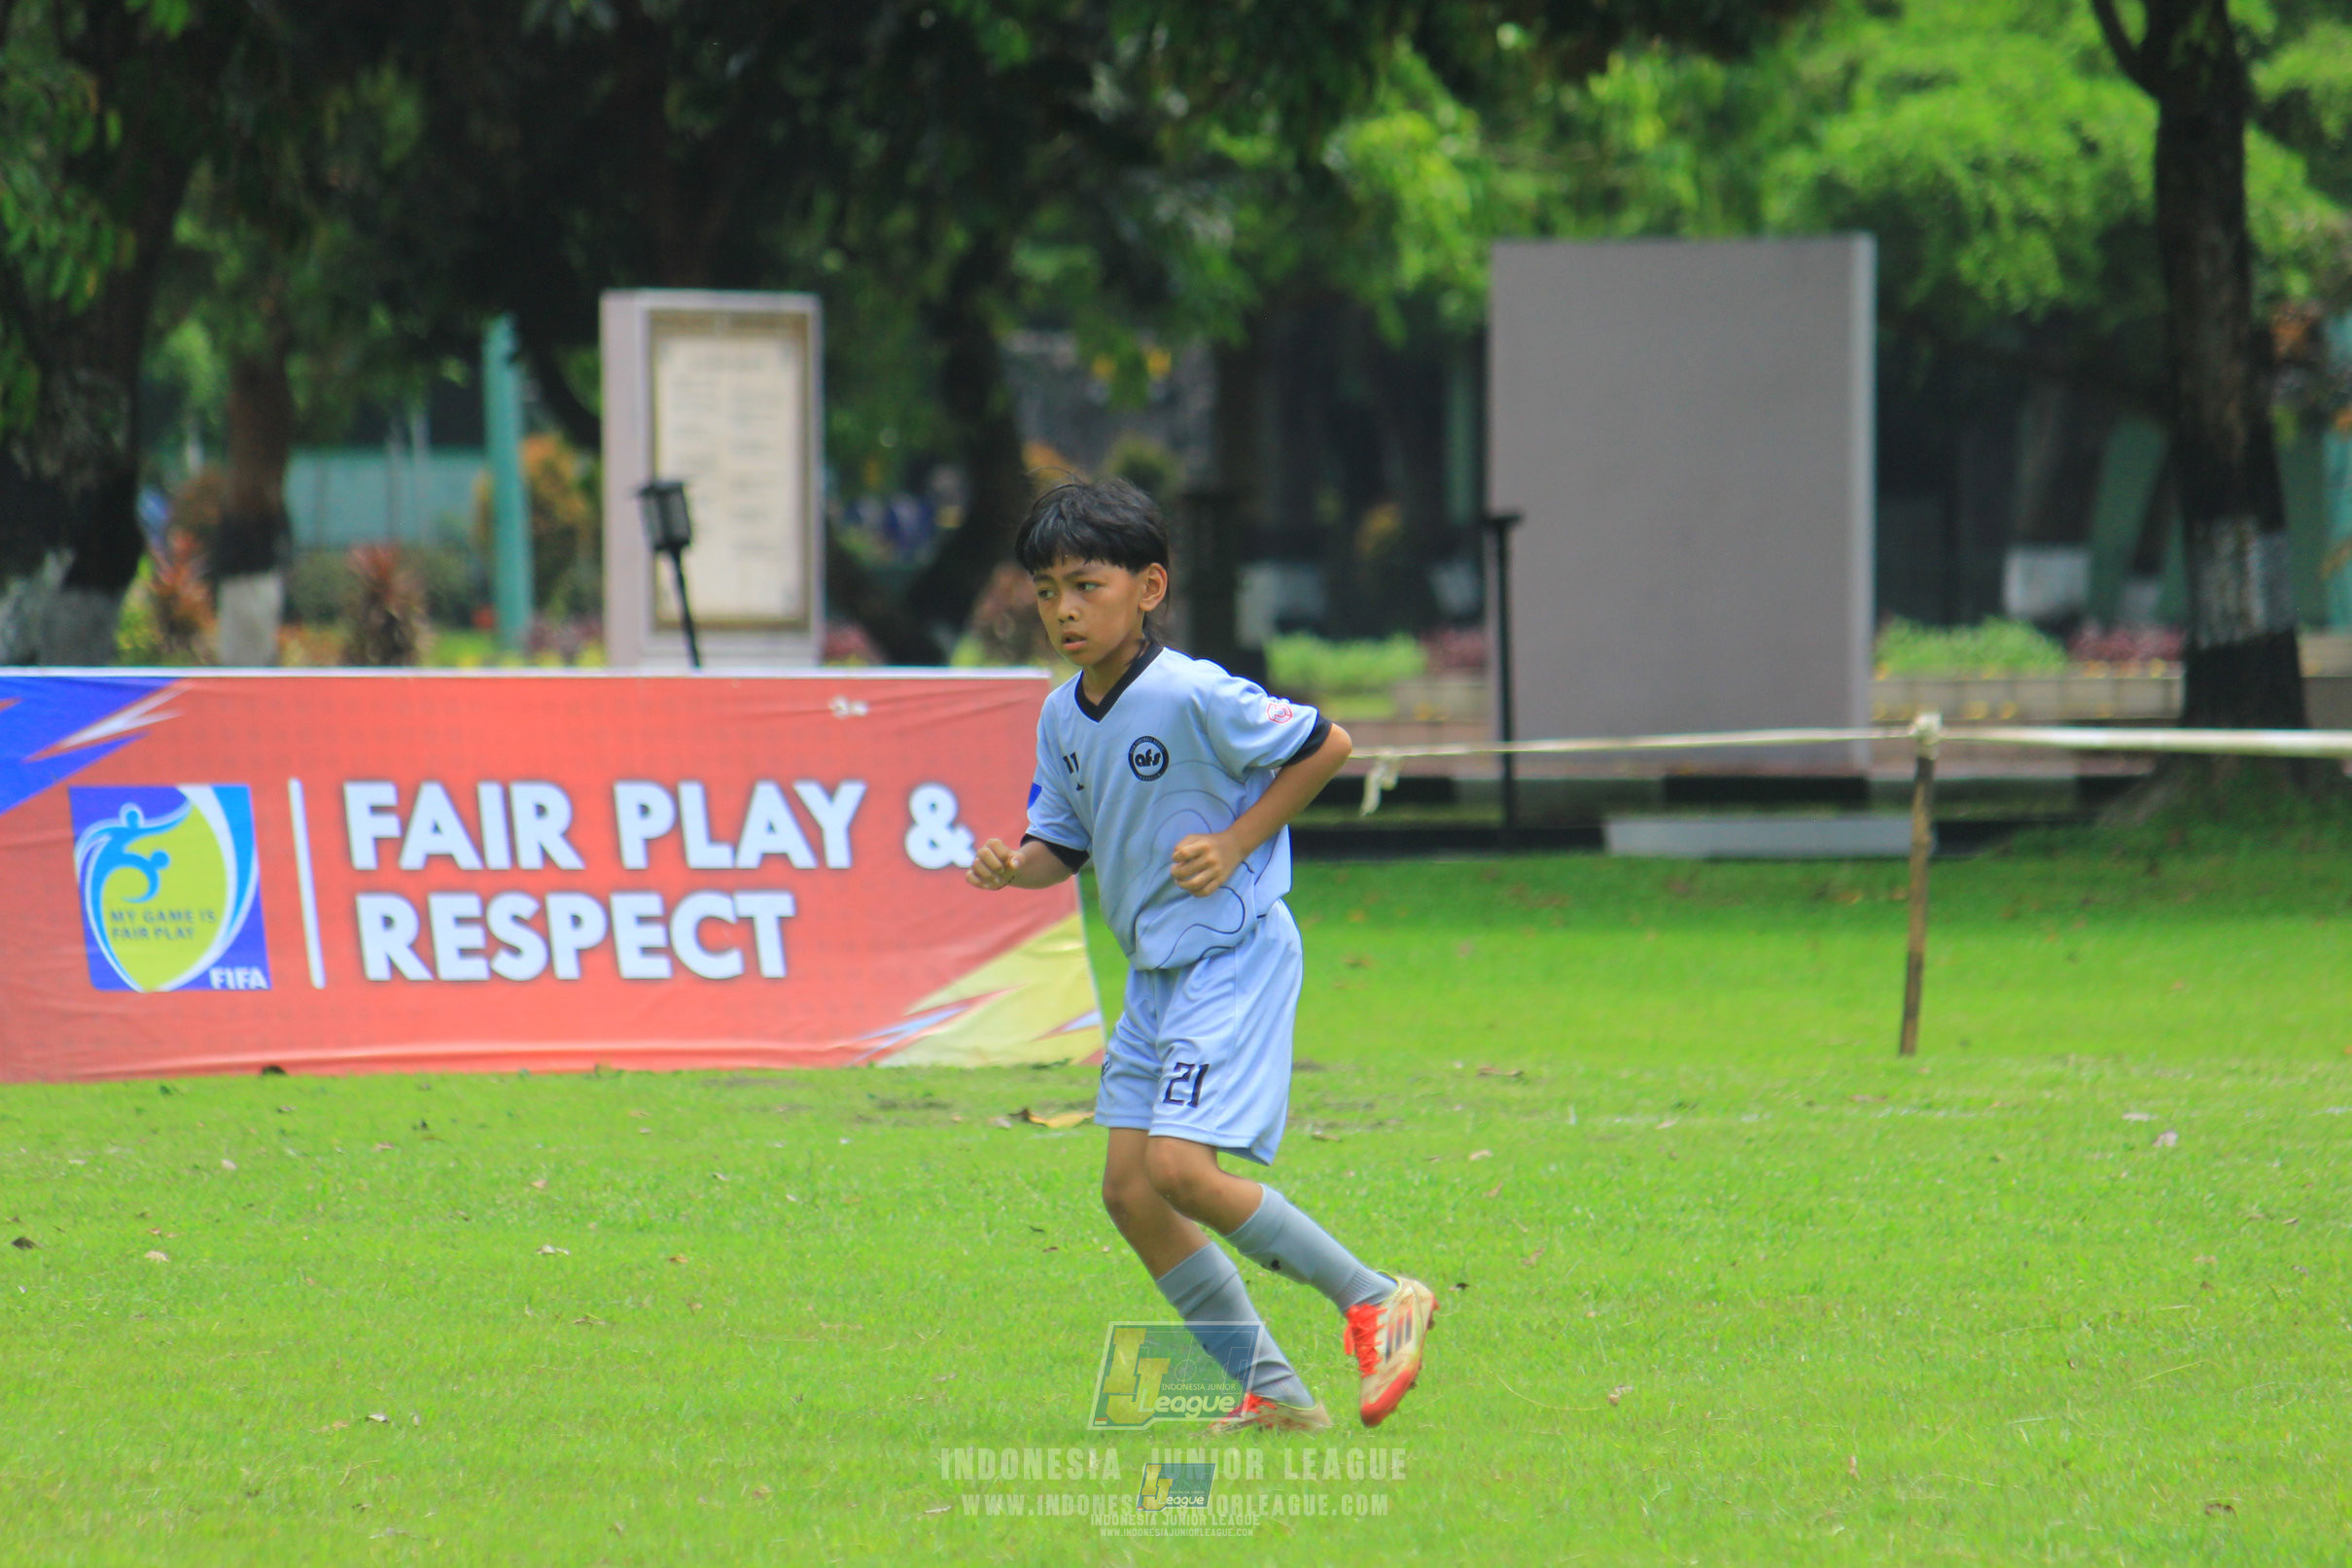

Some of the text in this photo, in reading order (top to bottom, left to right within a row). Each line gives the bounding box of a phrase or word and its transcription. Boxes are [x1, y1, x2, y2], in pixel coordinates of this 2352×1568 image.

[343, 780, 977, 871] FAIR PLAY &
[110, 909, 217, 923] MY GAME IS
[112, 926, 196, 941] FAIR PLAY
[355, 890, 796, 982] RESPECT
[209, 967, 270, 991] FIFA
[1163, 1062, 1210, 1108] 21
